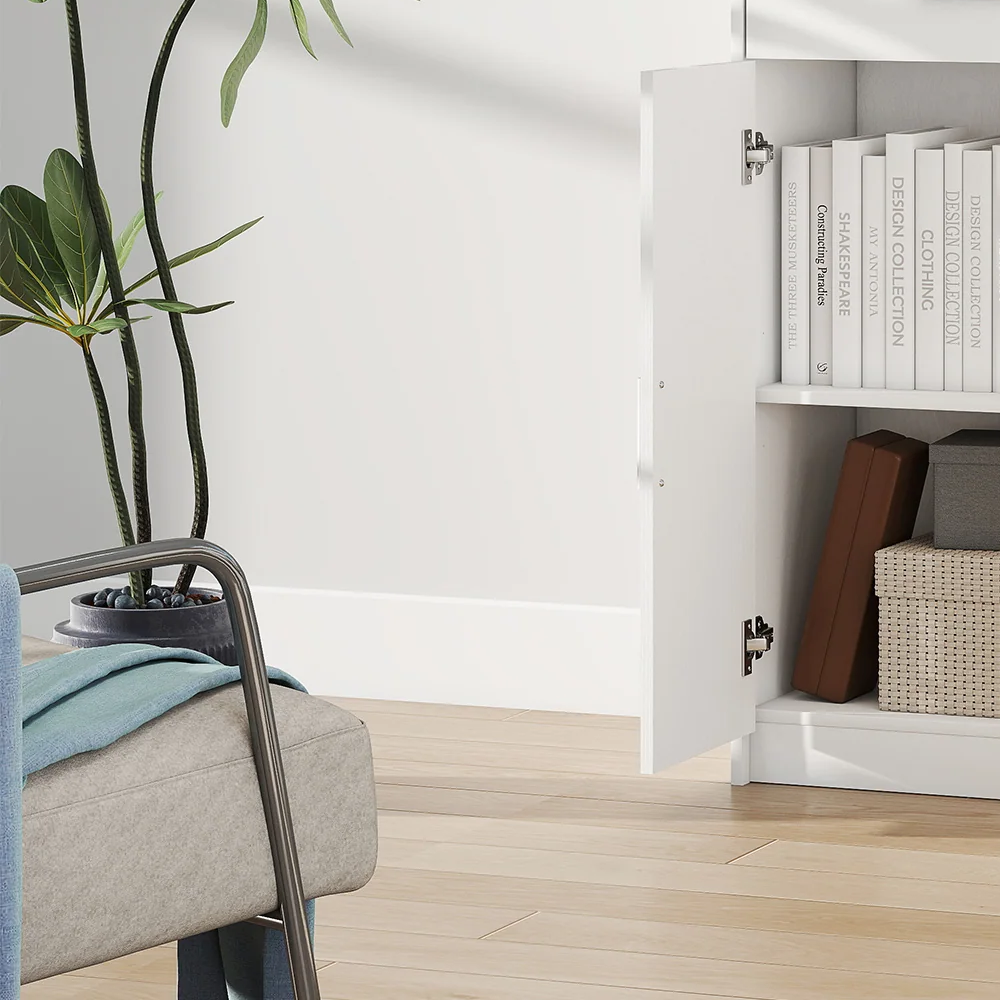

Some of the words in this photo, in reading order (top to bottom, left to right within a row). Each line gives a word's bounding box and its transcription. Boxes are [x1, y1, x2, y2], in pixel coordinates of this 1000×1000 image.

[788, 182, 797, 270] MUSKETEERS
[814, 204, 828, 264] Constructing
[869, 226, 878, 247] MY
[892, 177, 904, 238] DESIGN
[945, 190, 960, 247] DESIGN
[970, 195, 981, 251] DESIGN
[817, 267, 828, 306] Paradies
[838, 212, 851, 316] SHAKESPEARE
[869, 252, 878, 317] ANTONIA
[892, 242, 904, 347] COLLECTION
[921, 229, 934, 311] CLOTHING
[788, 275, 797, 320] THREE
[945, 252, 960, 346] COLLECTION
[970, 256, 981, 348] COLLECTION
[788, 322, 797, 350] THE
